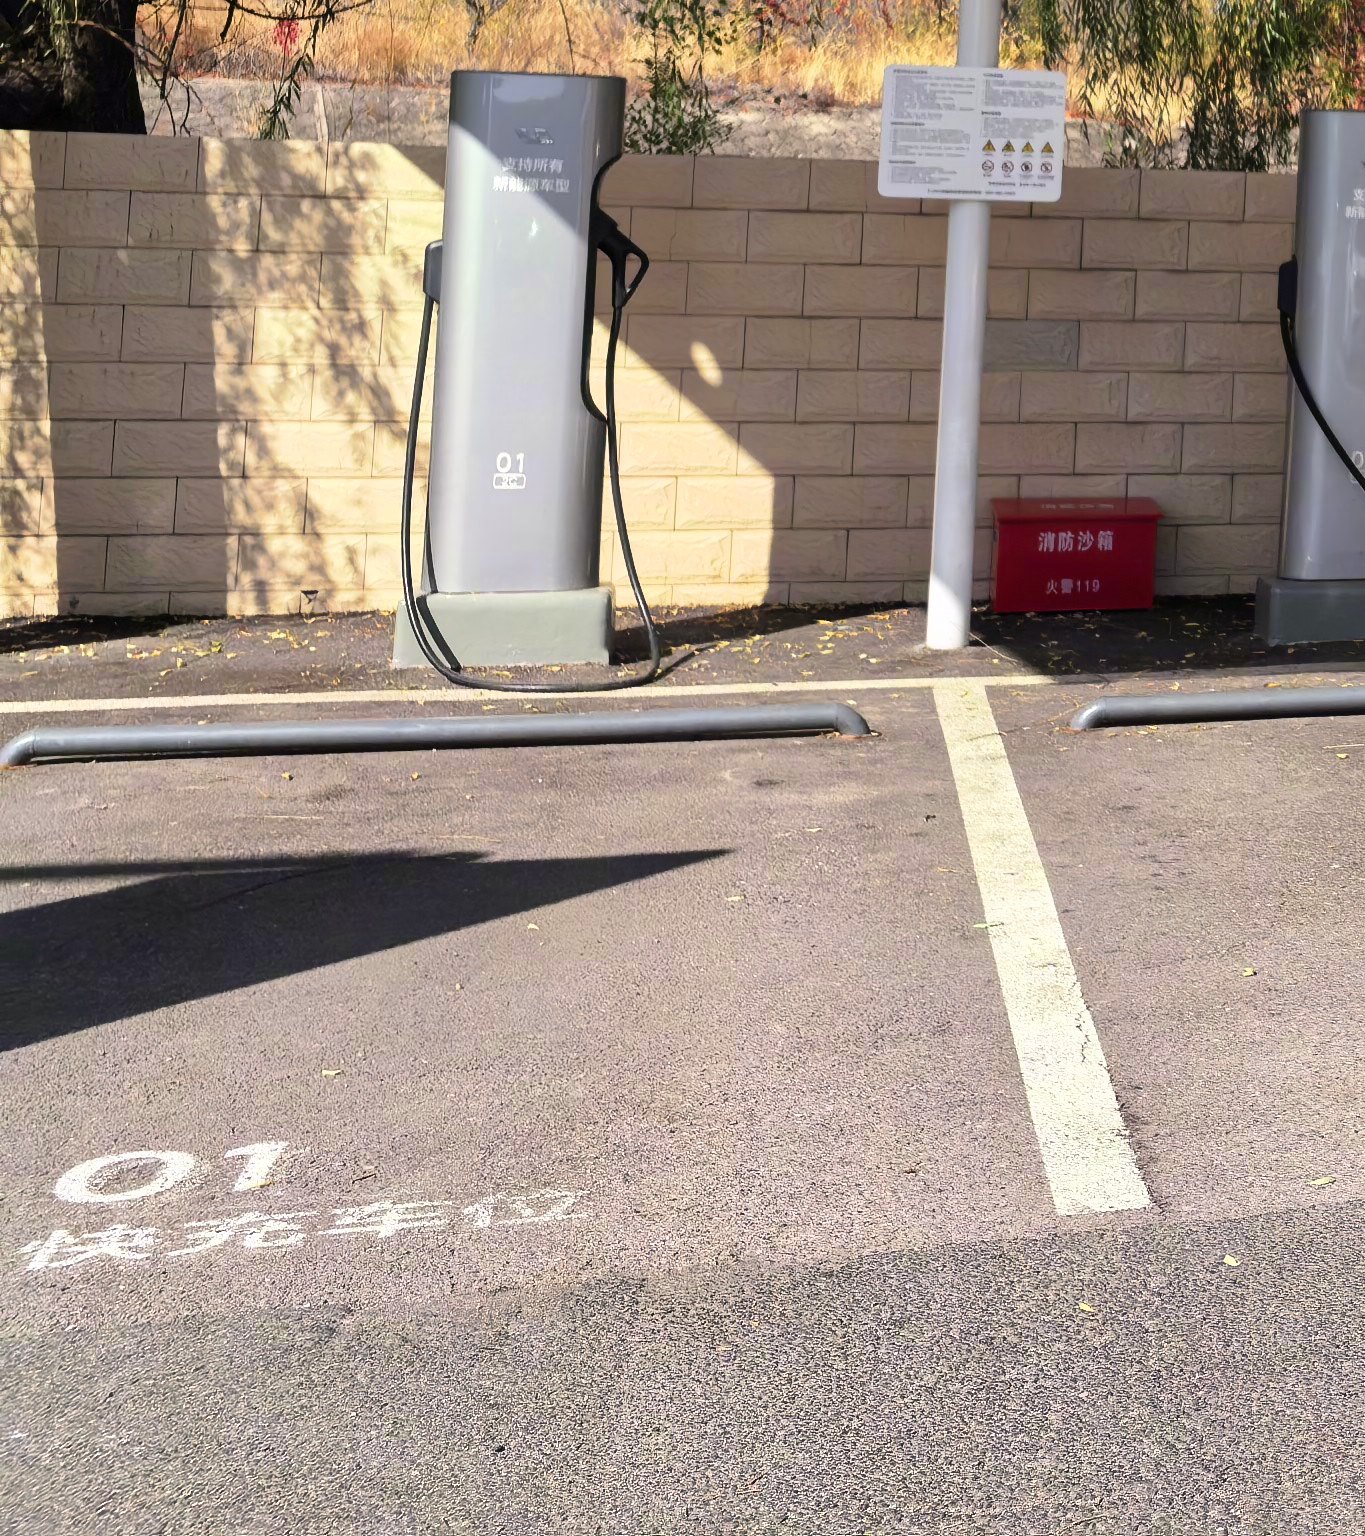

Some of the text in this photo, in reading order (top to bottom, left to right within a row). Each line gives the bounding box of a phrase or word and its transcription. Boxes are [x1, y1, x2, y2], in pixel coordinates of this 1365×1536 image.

[496, 452, 525, 473] 01
[1038, 530, 1114, 552] 消防沙箱
[52, 1140, 290, 1203] 01
